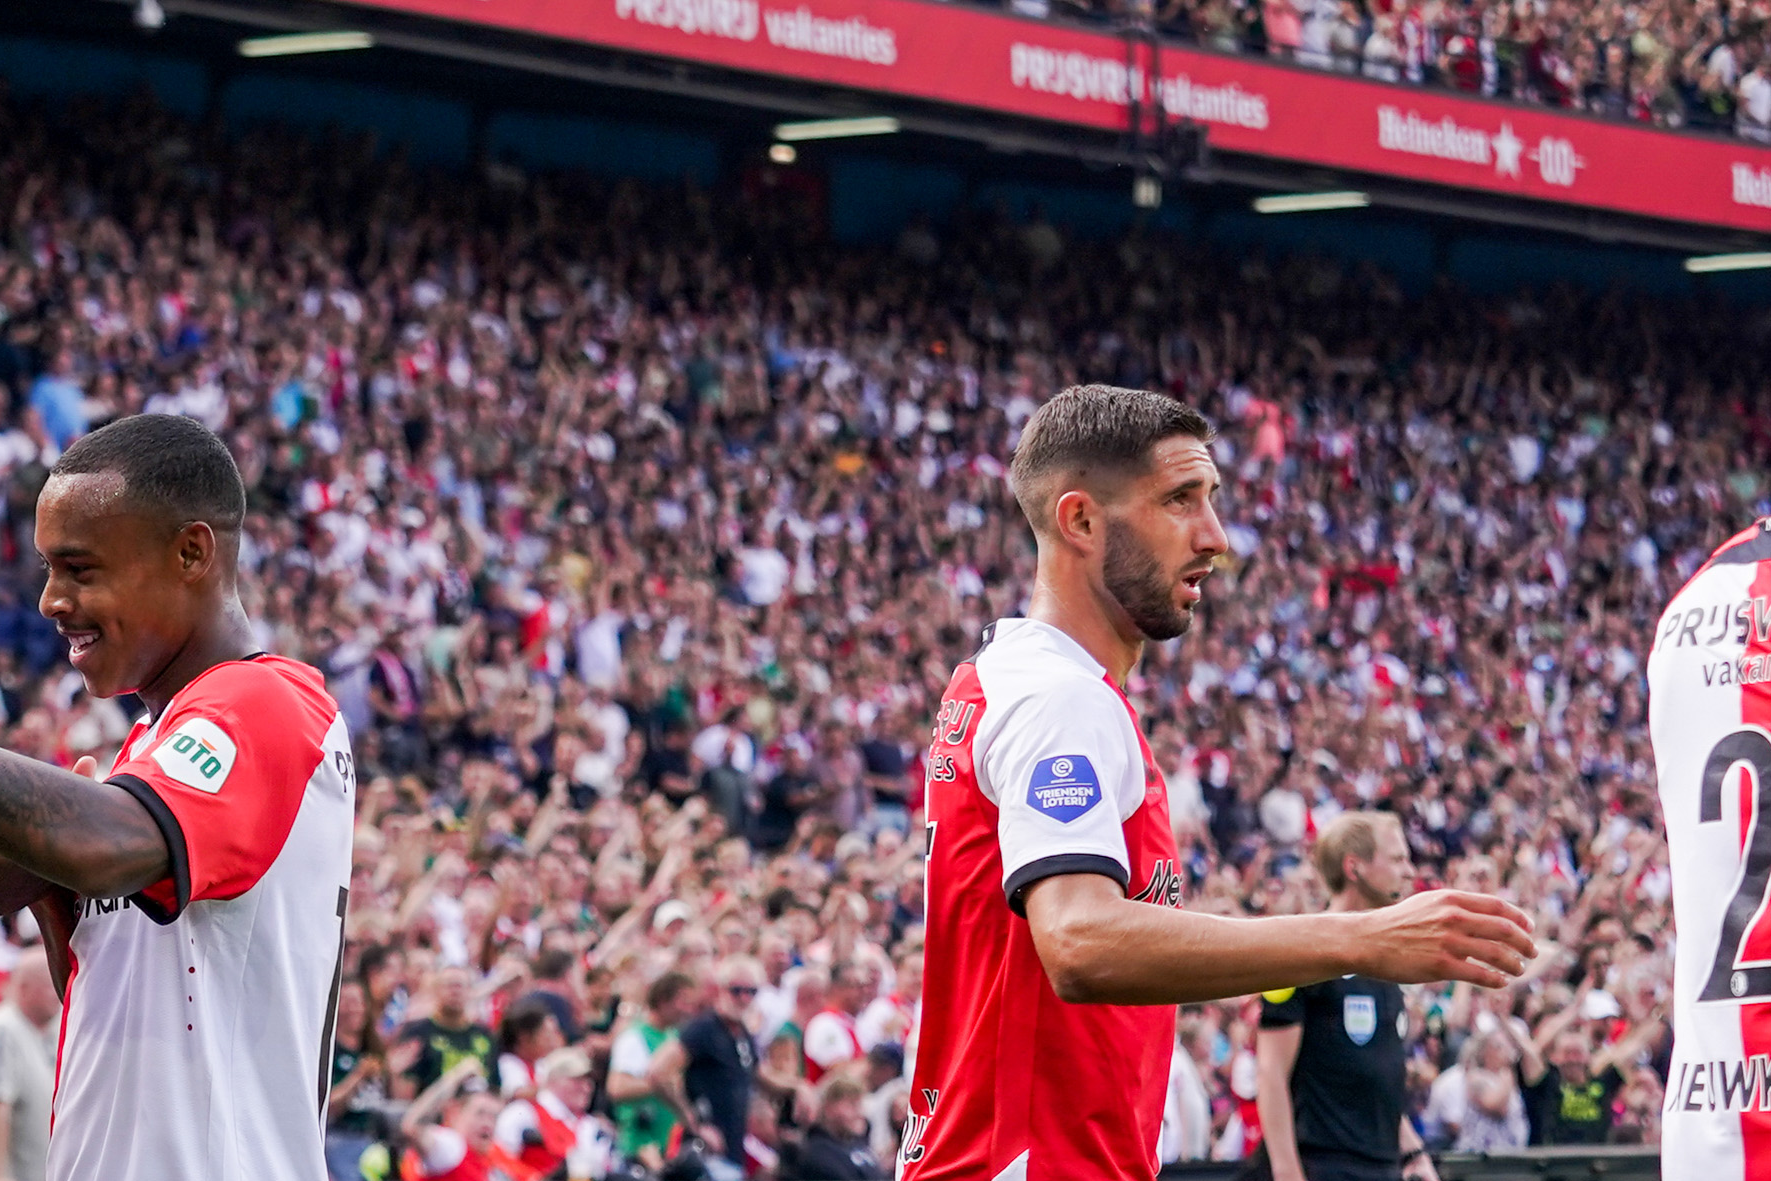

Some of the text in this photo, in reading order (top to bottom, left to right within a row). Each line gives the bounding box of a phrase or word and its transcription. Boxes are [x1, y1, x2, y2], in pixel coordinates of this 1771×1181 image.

[1377, 104, 1492, 166] Heineken
[1034, 787, 1094, 800] VRIENDEN
[1042, 796, 1087, 809] LOTERIJ
